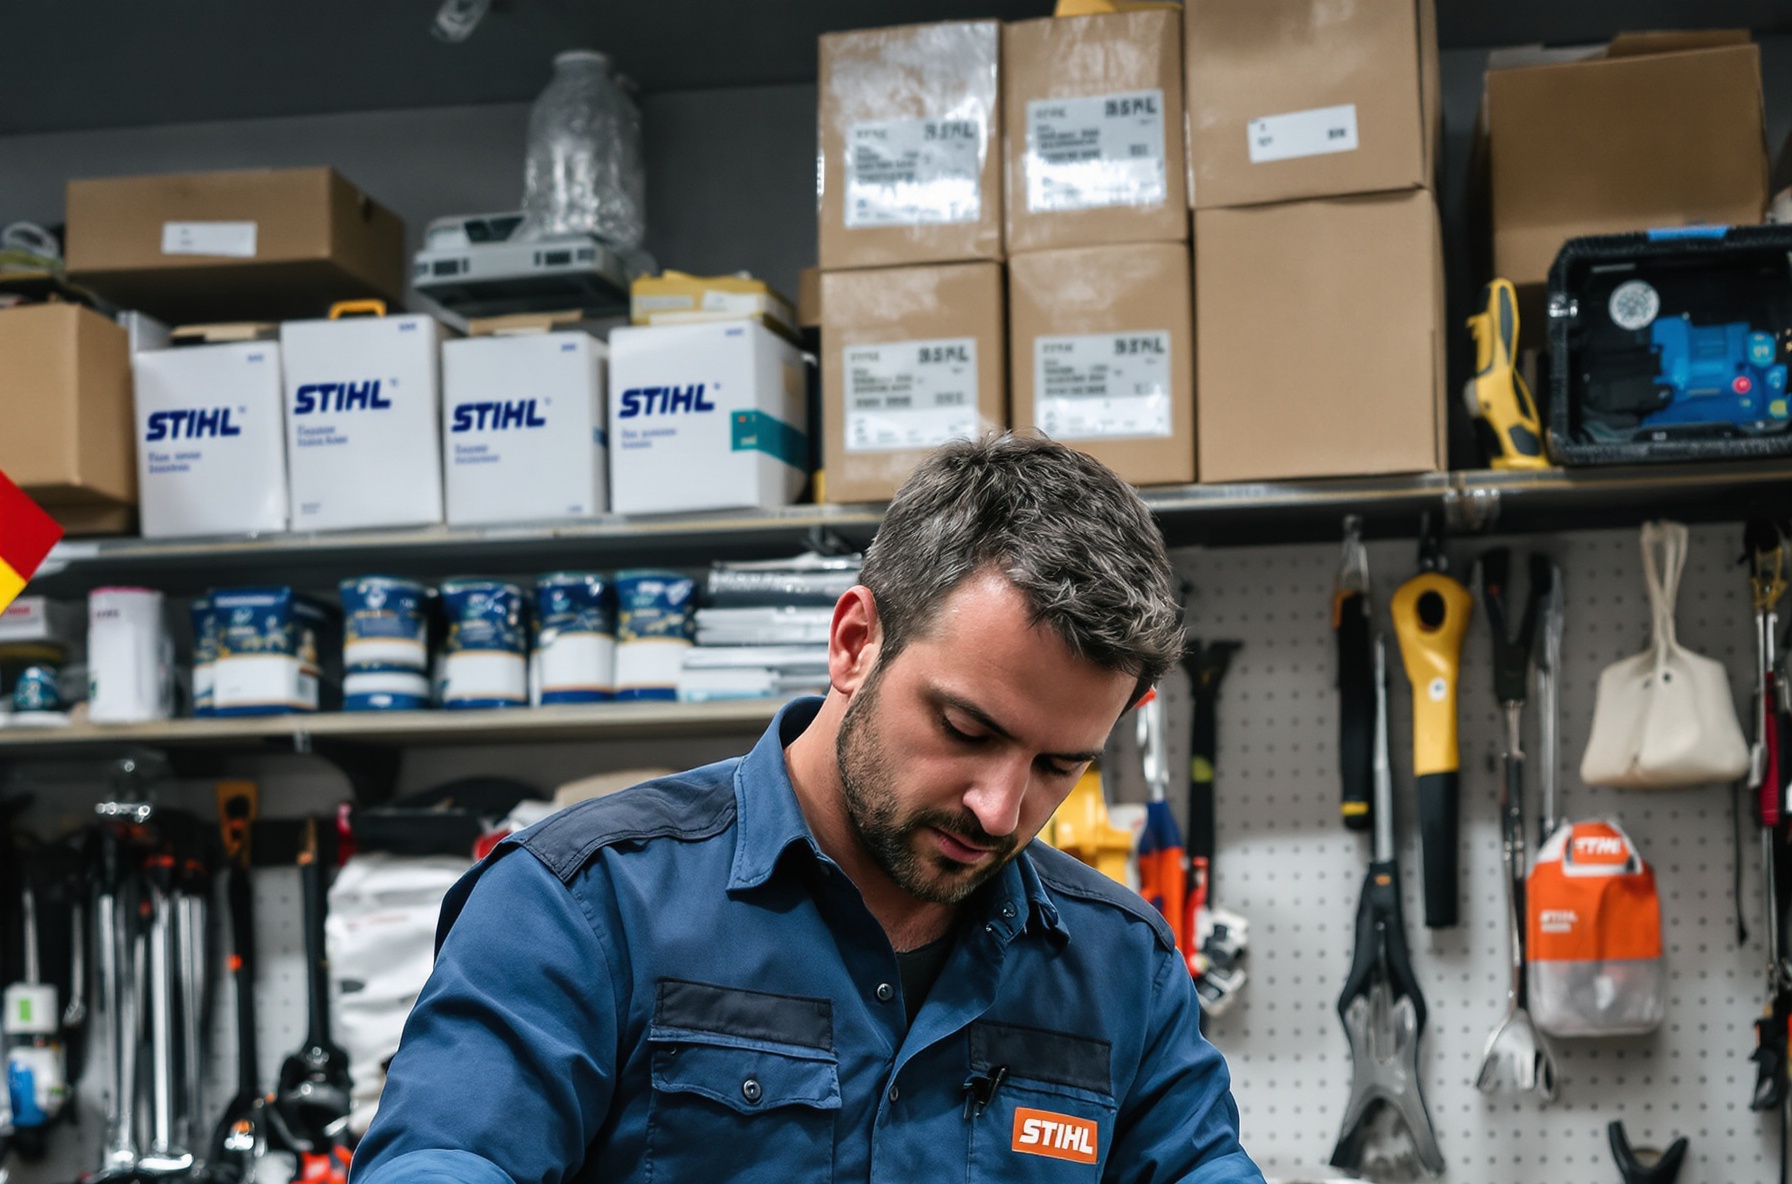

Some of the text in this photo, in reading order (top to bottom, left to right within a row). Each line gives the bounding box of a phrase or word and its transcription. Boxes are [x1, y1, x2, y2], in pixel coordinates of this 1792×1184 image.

[294, 379, 392, 415] STIHL
[618, 384, 715, 418] STIHL
[146, 407, 241, 441] STIHL
[451, 399, 546, 433] STIHL
[1019, 1118, 1093, 1155] STIHL
